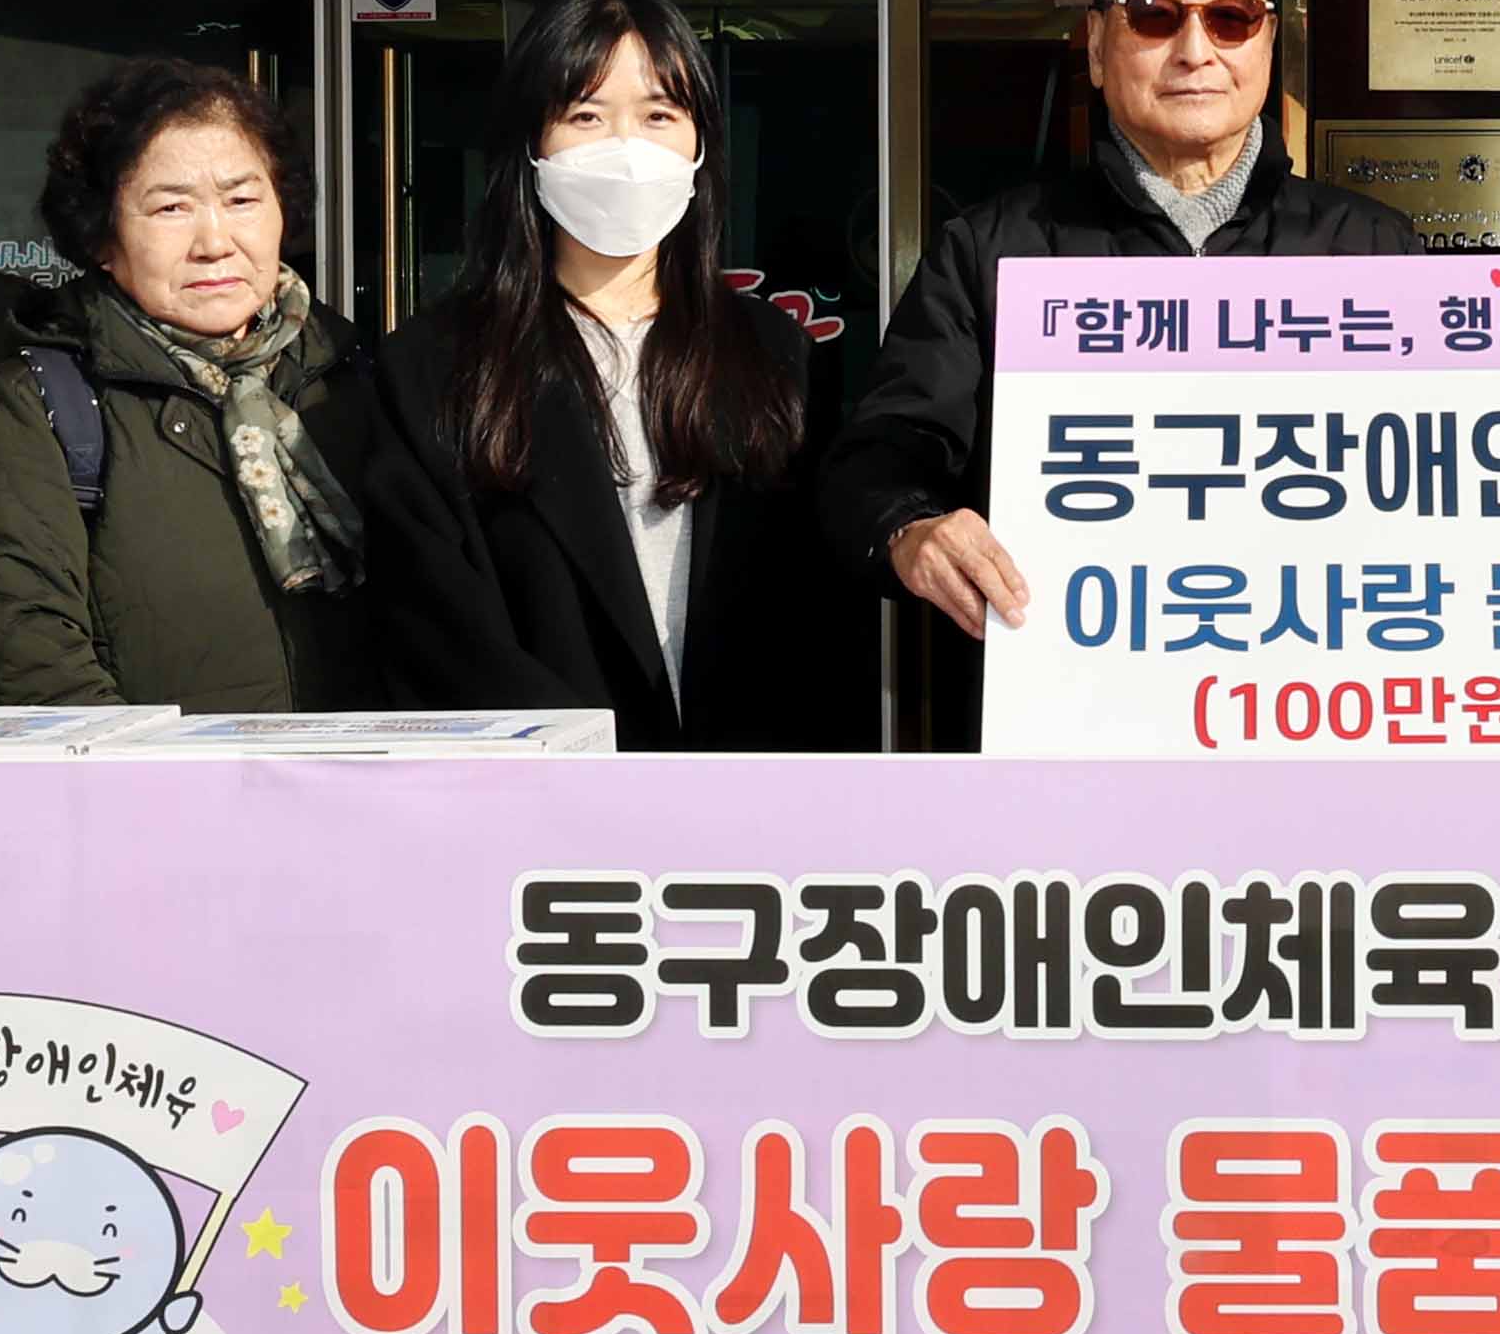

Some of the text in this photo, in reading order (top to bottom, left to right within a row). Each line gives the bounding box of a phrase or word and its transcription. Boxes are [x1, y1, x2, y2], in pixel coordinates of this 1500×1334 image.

[1434, 54, 1463, 64] unicef
[1217, 297, 1415, 356] 나누는,
[1064, 560, 1456, 655] 이웃사랑
